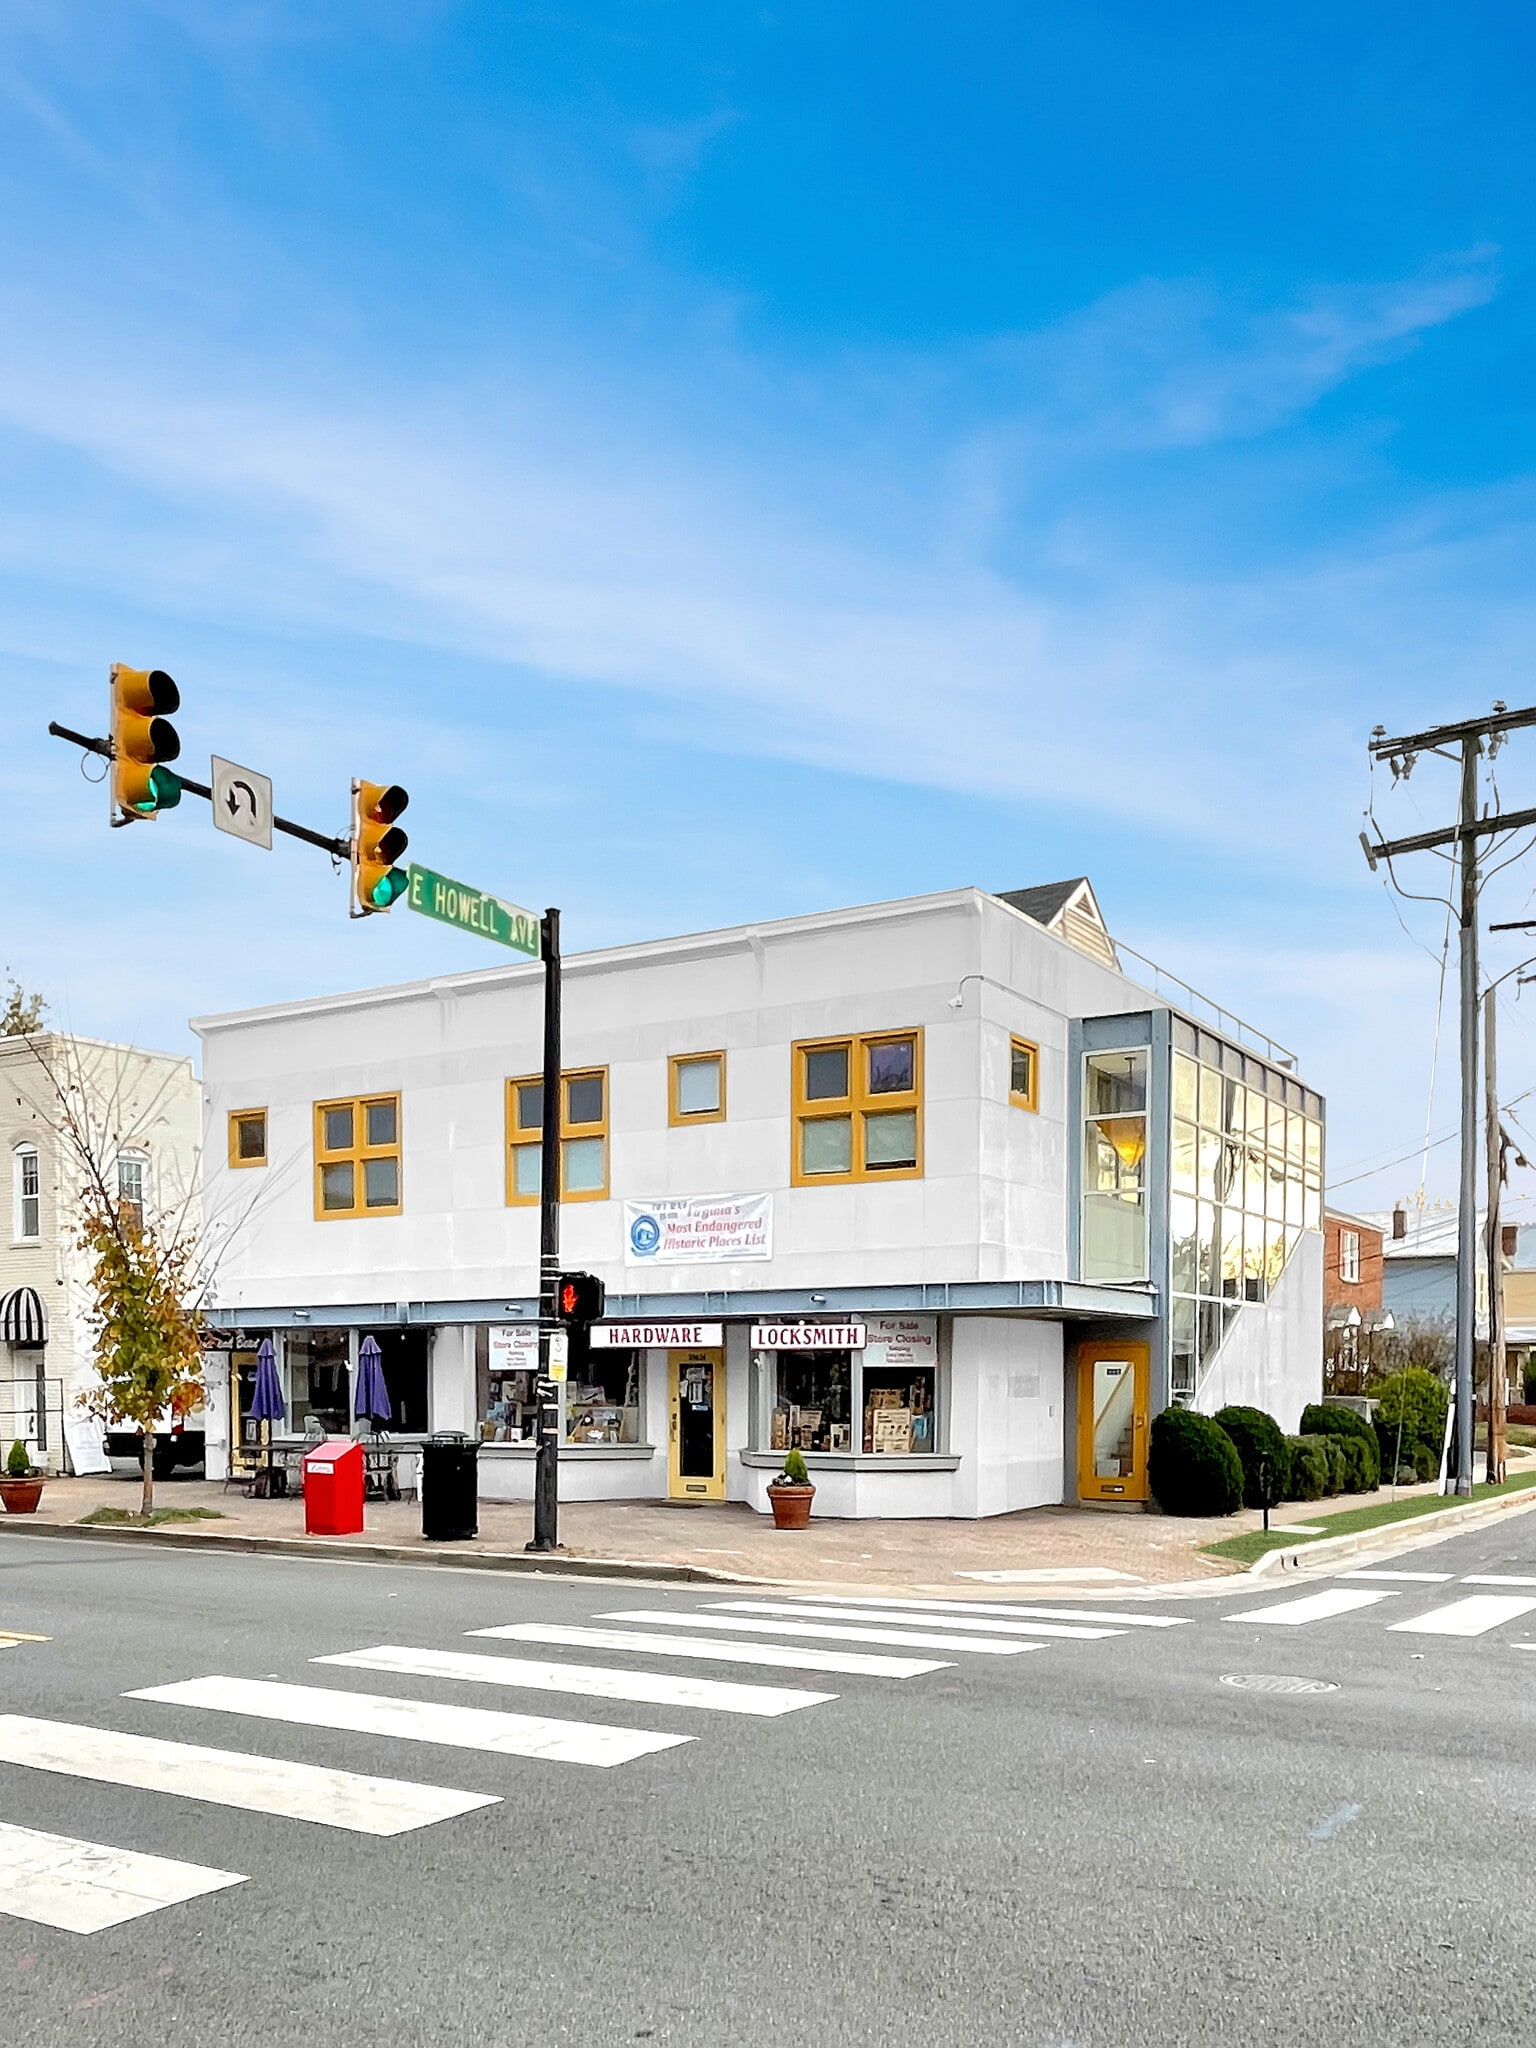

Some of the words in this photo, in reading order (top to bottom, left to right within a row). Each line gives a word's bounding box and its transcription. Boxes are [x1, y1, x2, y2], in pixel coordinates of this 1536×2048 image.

[412, 873, 424, 905] E
[434, 882, 499, 935] HOWELL
[510, 913, 536, 949] AVE
[667, 1222, 692, 1234] Most
[695, 1217, 763, 1233] Endangered
[663, 1238, 706, 1250] Historic
[709, 1235, 742, 1247] Places
[744, 1233, 767, 1246] List
[880, 1321, 896, 1329] For
[898, 1321, 919, 1330] Sale
[609, 1327, 703, 1344] HARDWARE
[758, 1327, 858, 1345] LOCKSMITH
[895, 1333, 932, 1345] Closing
